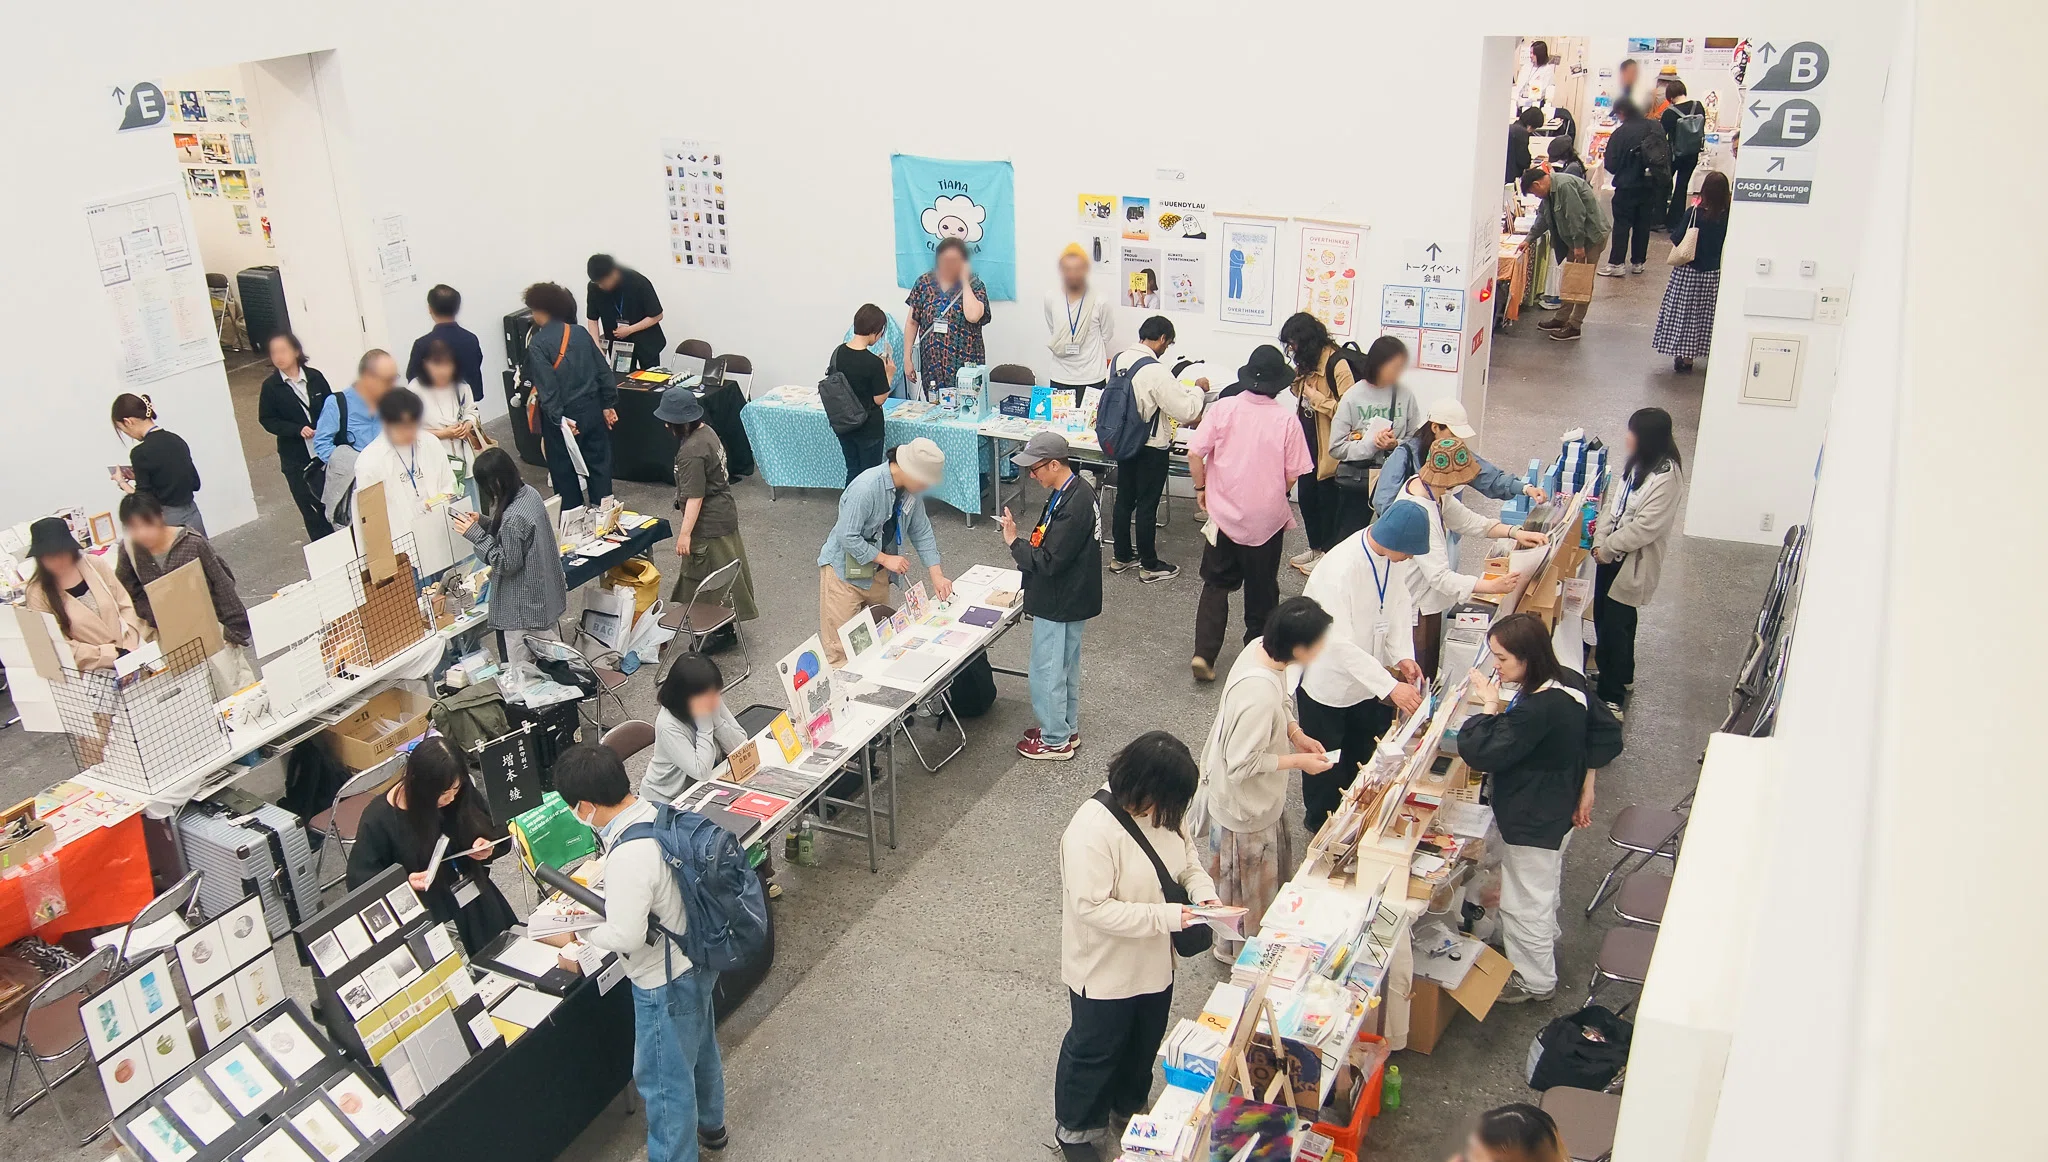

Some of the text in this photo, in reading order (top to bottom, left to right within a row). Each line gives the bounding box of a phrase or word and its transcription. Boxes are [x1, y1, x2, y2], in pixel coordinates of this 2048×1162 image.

[1789, 51, 1819, 84] B
[136, 90, 160, 119] E
[1781, 108, 1810, 140] E
[1736, 181, 1810, 194] CASO Art Lounge
[1747, 191, 1761, 199] Cafe
[1778, 192, 1796, 200] Event
[1164, 200, 1206, 210] UUENDYLAU
[1309, 236, 1350, 246] OVERTHINKER
[1405, 262, 1461, 275] トークイベント
[1423, 274, 1441, 284] 会場
[1227, 306, 1265, 315] OVERTHINKER
[1356, 402, 1403, 420] Mari
[742, 743, 755, 755] AUTO
